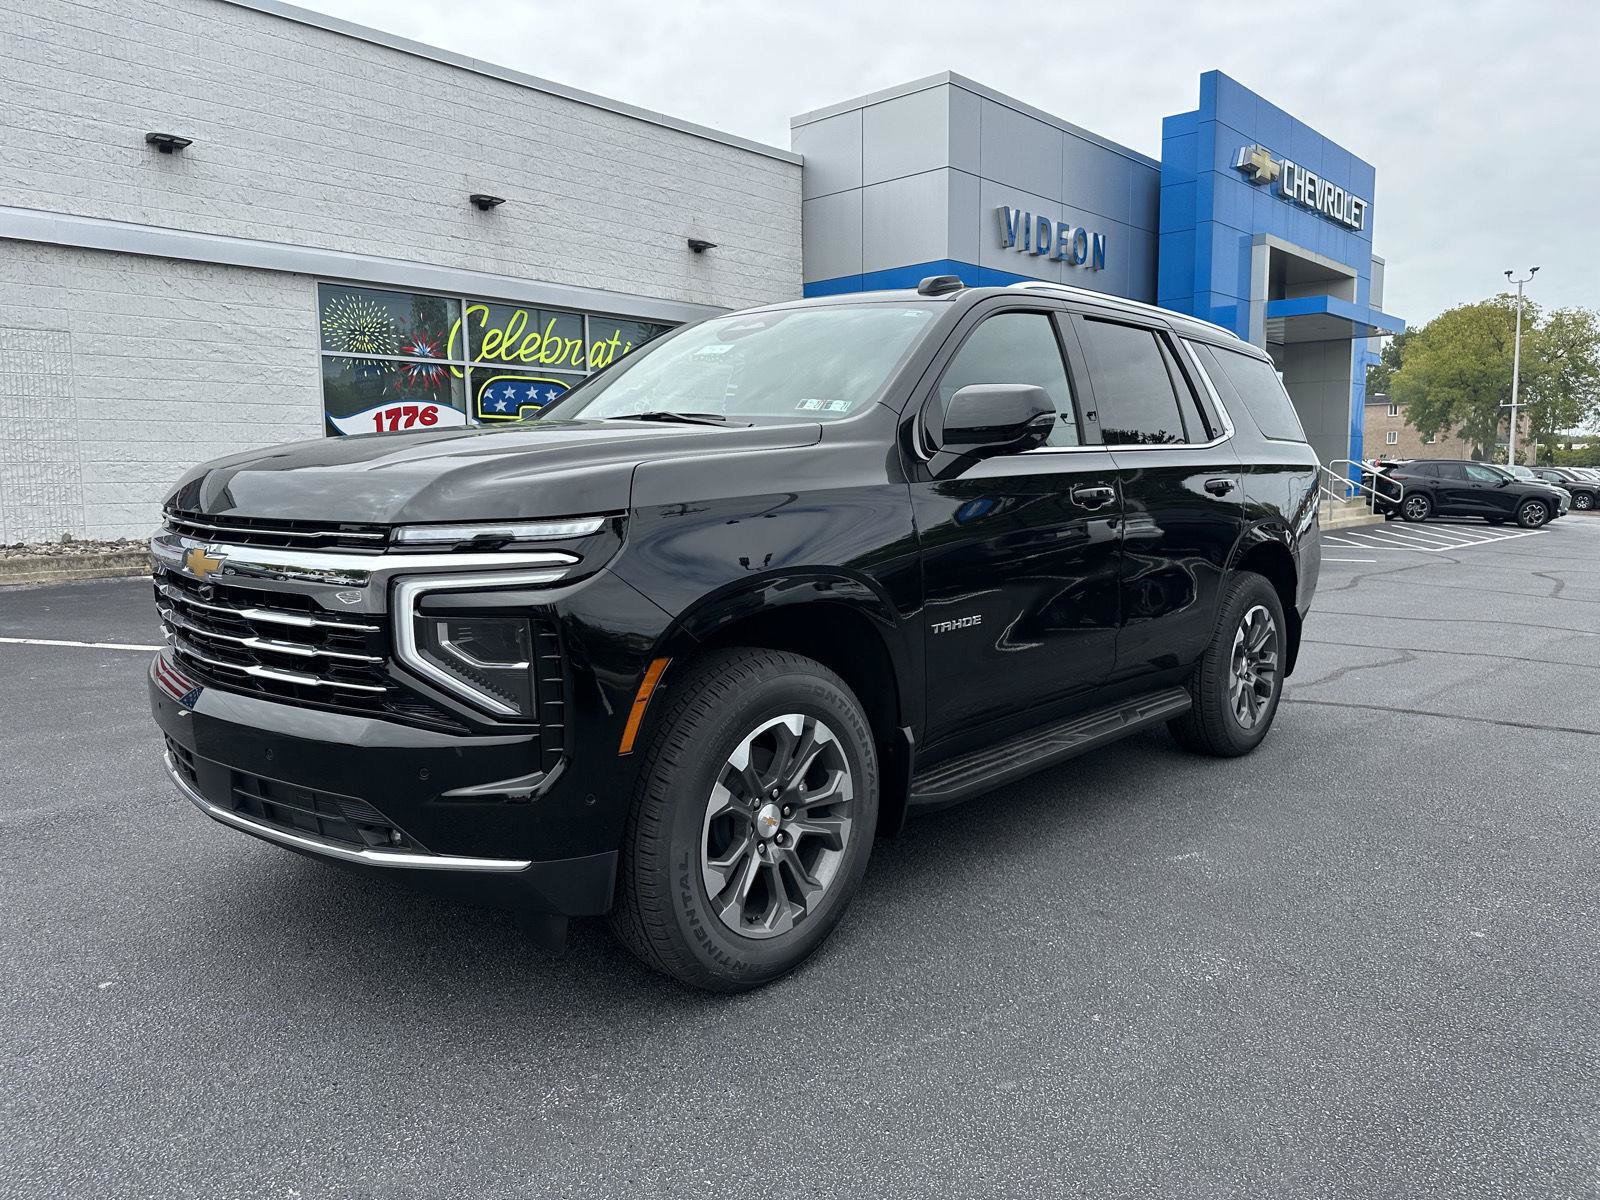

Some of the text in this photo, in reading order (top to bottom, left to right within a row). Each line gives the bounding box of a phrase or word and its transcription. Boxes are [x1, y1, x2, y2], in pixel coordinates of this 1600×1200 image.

[1280, 159, 1368, 230] CHEVROLET
[997, 205, 1106, 271] VIDEON
[373, 405, 439, 432] 1776
[930, 614, 982, 634] TAHOE
